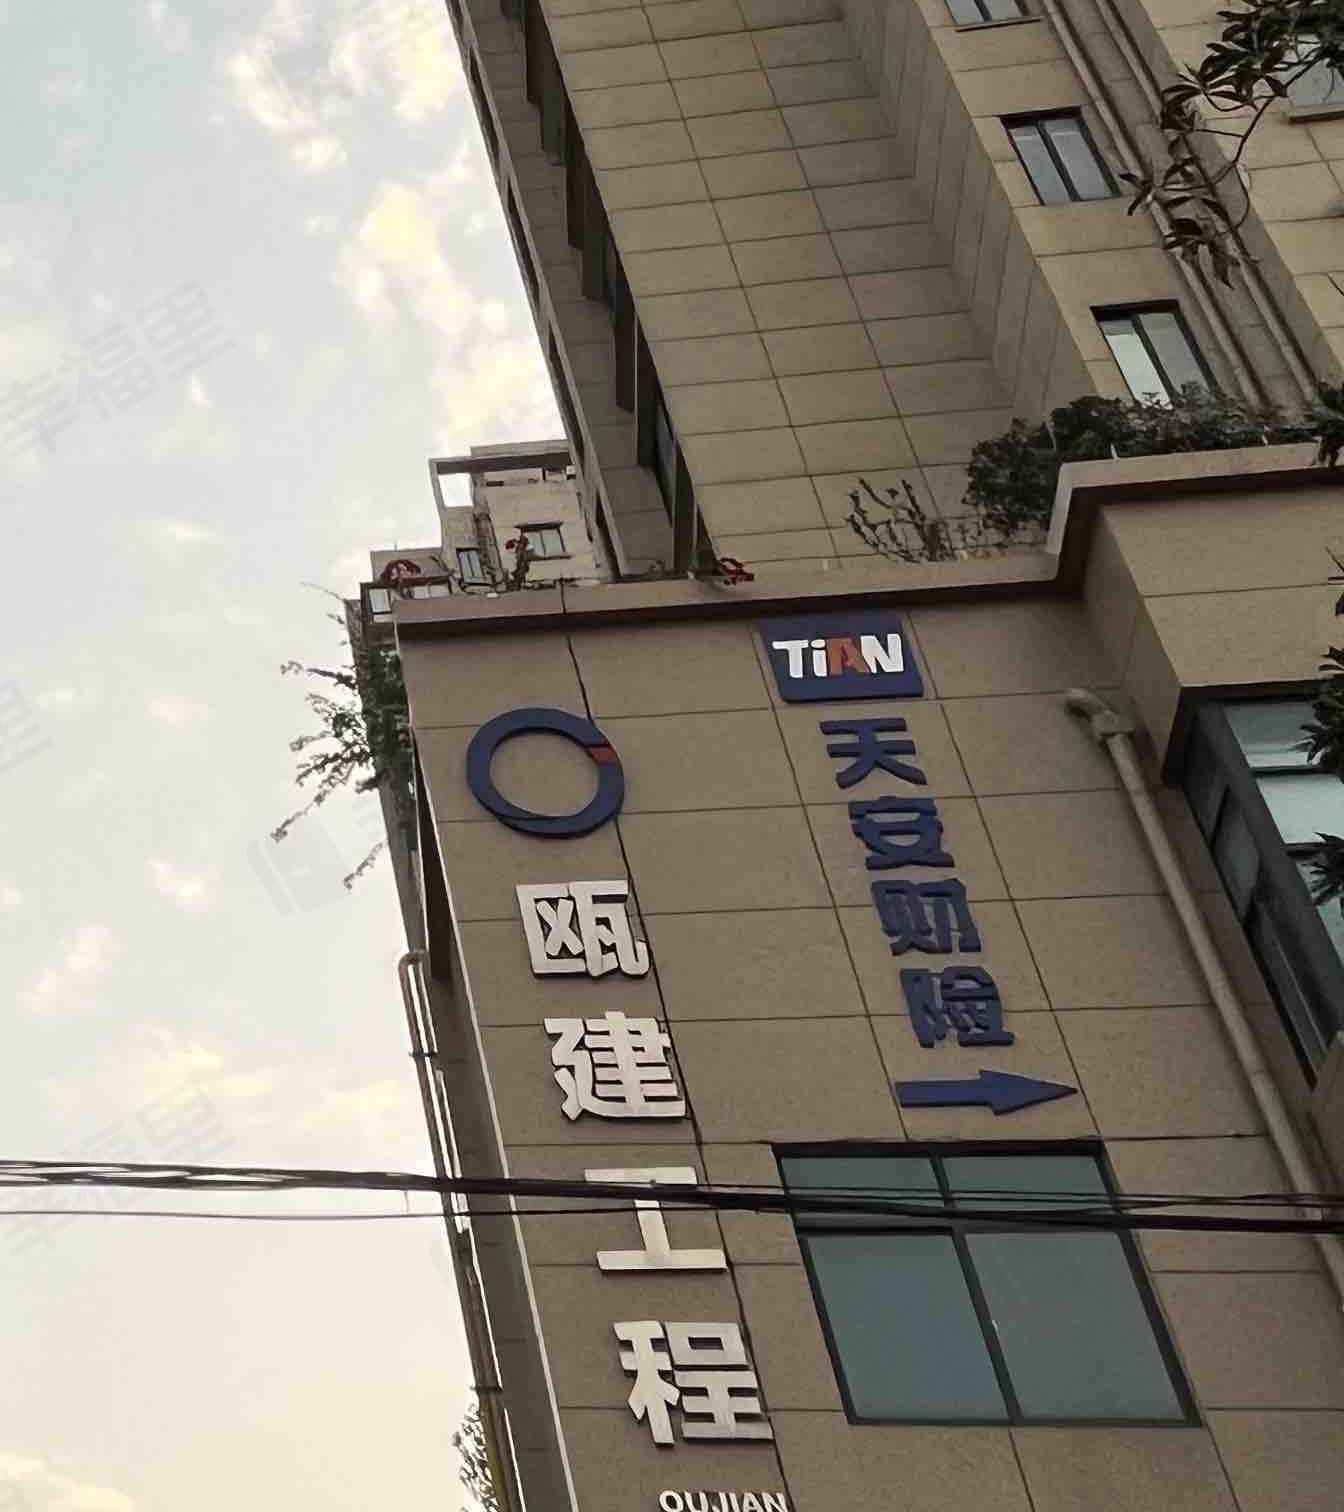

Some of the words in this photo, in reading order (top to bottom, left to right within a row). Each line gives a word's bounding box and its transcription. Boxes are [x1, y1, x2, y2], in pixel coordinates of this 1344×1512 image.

[819, 717, 1015, 1049] 天安财险
[516, 878, 774, 1447] 瓯建工程
